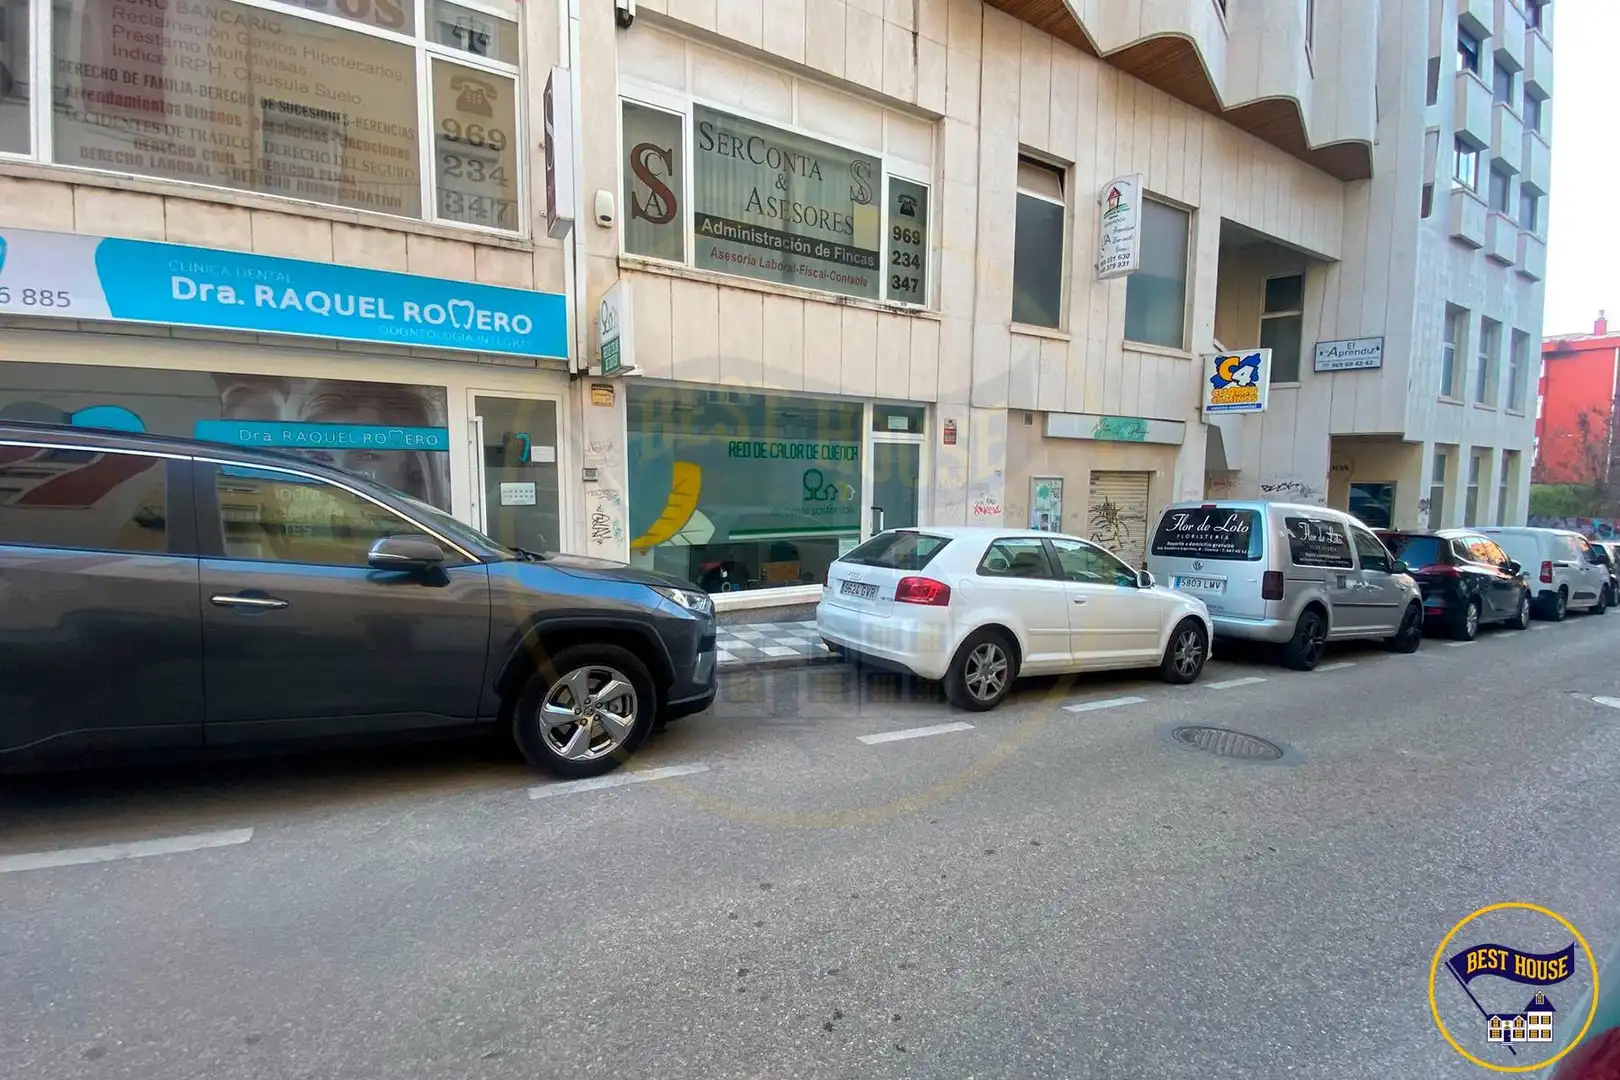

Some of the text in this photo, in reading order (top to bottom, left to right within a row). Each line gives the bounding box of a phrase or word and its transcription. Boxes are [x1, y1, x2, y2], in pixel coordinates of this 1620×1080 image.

[58, 59, 118, 81] DERECHO
[123, 70, 139, 86] DE
[441, 117, 507, 152] 969
[165, 123, 185, 138] DE
[362, 161, 415, 180] SEGURO
[444, 154, 509, 188] 234
[445, 190, 510, 223] 347
[745, 186, 854, 236] ASESORES
[701, 218, 876, 267] Administración de Fincas
[892, 225, 921, 246] 969
[892, 250, 921, 270] 234
[891, 275, 920, 294] 347
[22, 288, 71, 307] 885
[171, 275, 246, 306] Dra.
[254, 284, 395, 321] RAQUEL
[1327, 345, 1377, 358] Aprendiz
[1347, 342, 1356, 350] El
[239, 429, 272, 442] Dra
[283, 430, 358, 444] RAQUEL
[728, 440, 751, 458] RED
[753, 441, 767, 458] DE
[770, 442, 804, 459] CALOR
[806, 443, 819, 460] DE
[1166, 513, 1194, 532] Flor
[1213, 513, 1249, 533] Loto
[1181, 578, 1221, 590] 5803 LMV
